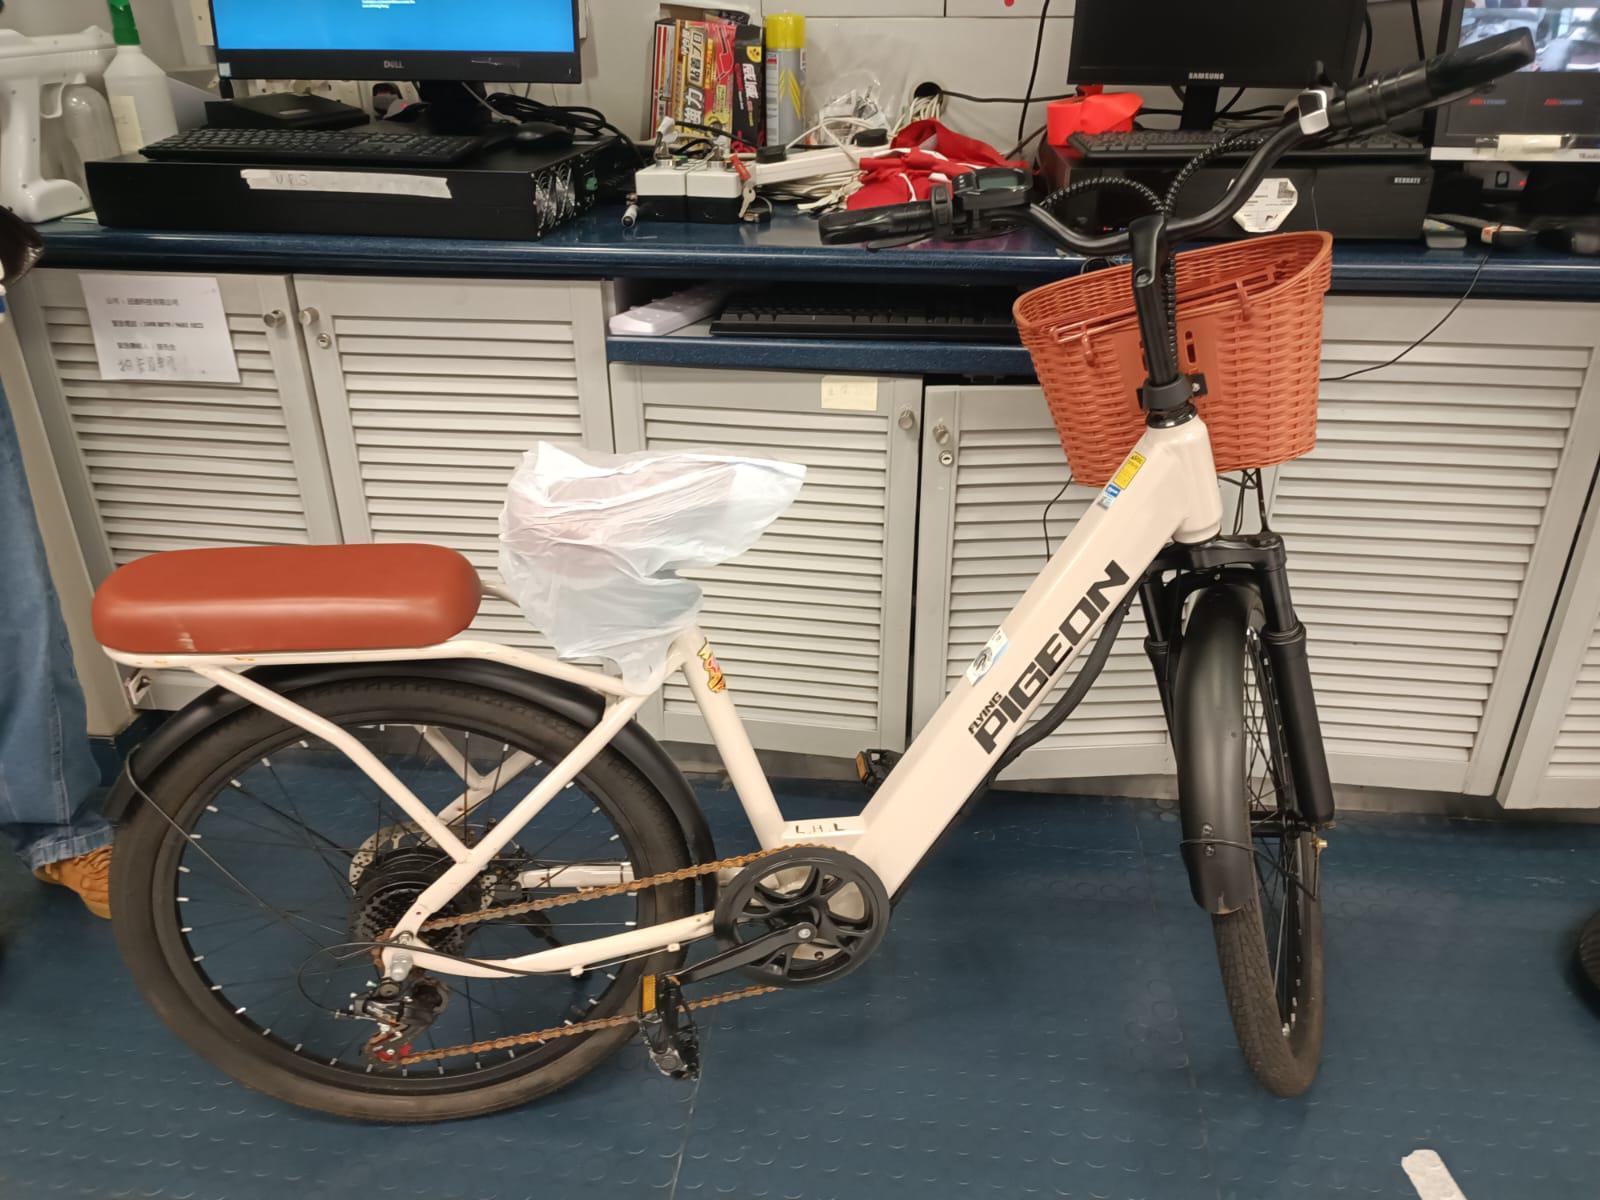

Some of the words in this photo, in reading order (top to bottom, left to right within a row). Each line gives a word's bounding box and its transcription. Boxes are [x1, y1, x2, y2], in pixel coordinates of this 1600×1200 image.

[1188, 72, 1225, 80] SAMSUNG
[974, 559, 1130, 755] PIGEON
[968, 691, 1003, 735] FLYING
